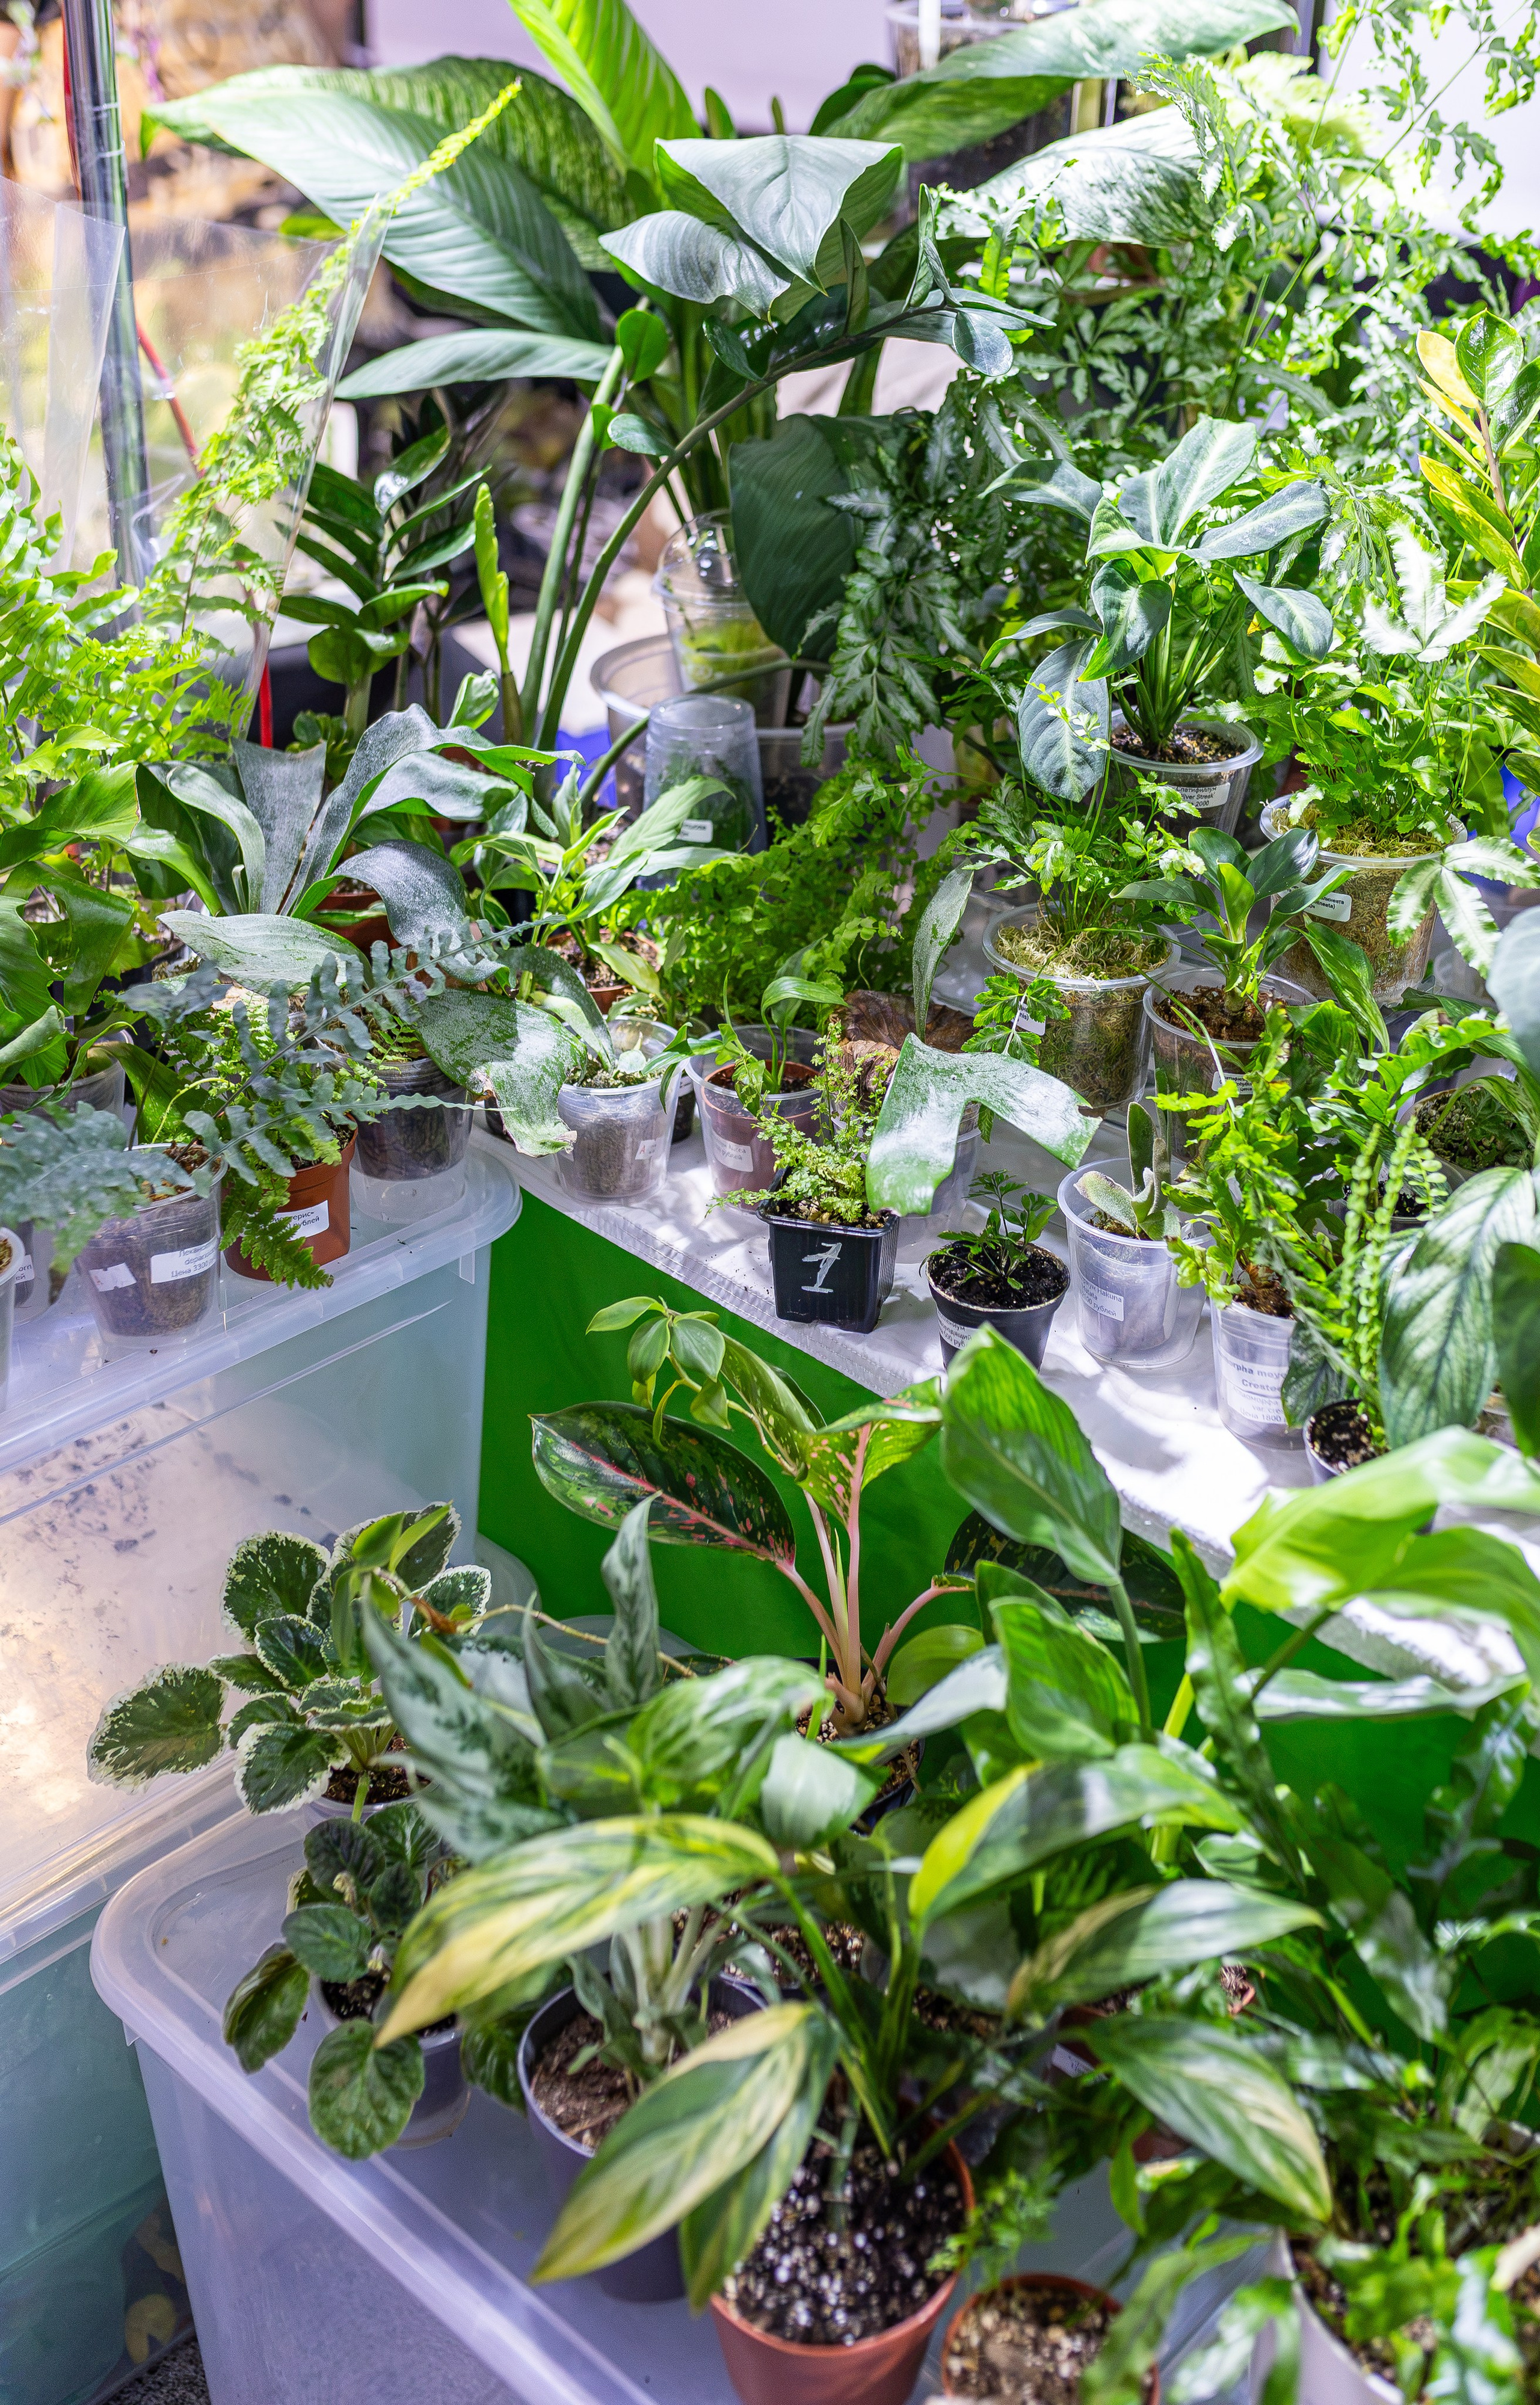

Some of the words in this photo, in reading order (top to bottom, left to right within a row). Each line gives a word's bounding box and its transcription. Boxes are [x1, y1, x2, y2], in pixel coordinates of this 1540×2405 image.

[1097, 1287, 1122, 1303] Hakuna
[1093, 1302, 1117, 1317] рублей
[1262, 1414, 1282, 1422] 1800
